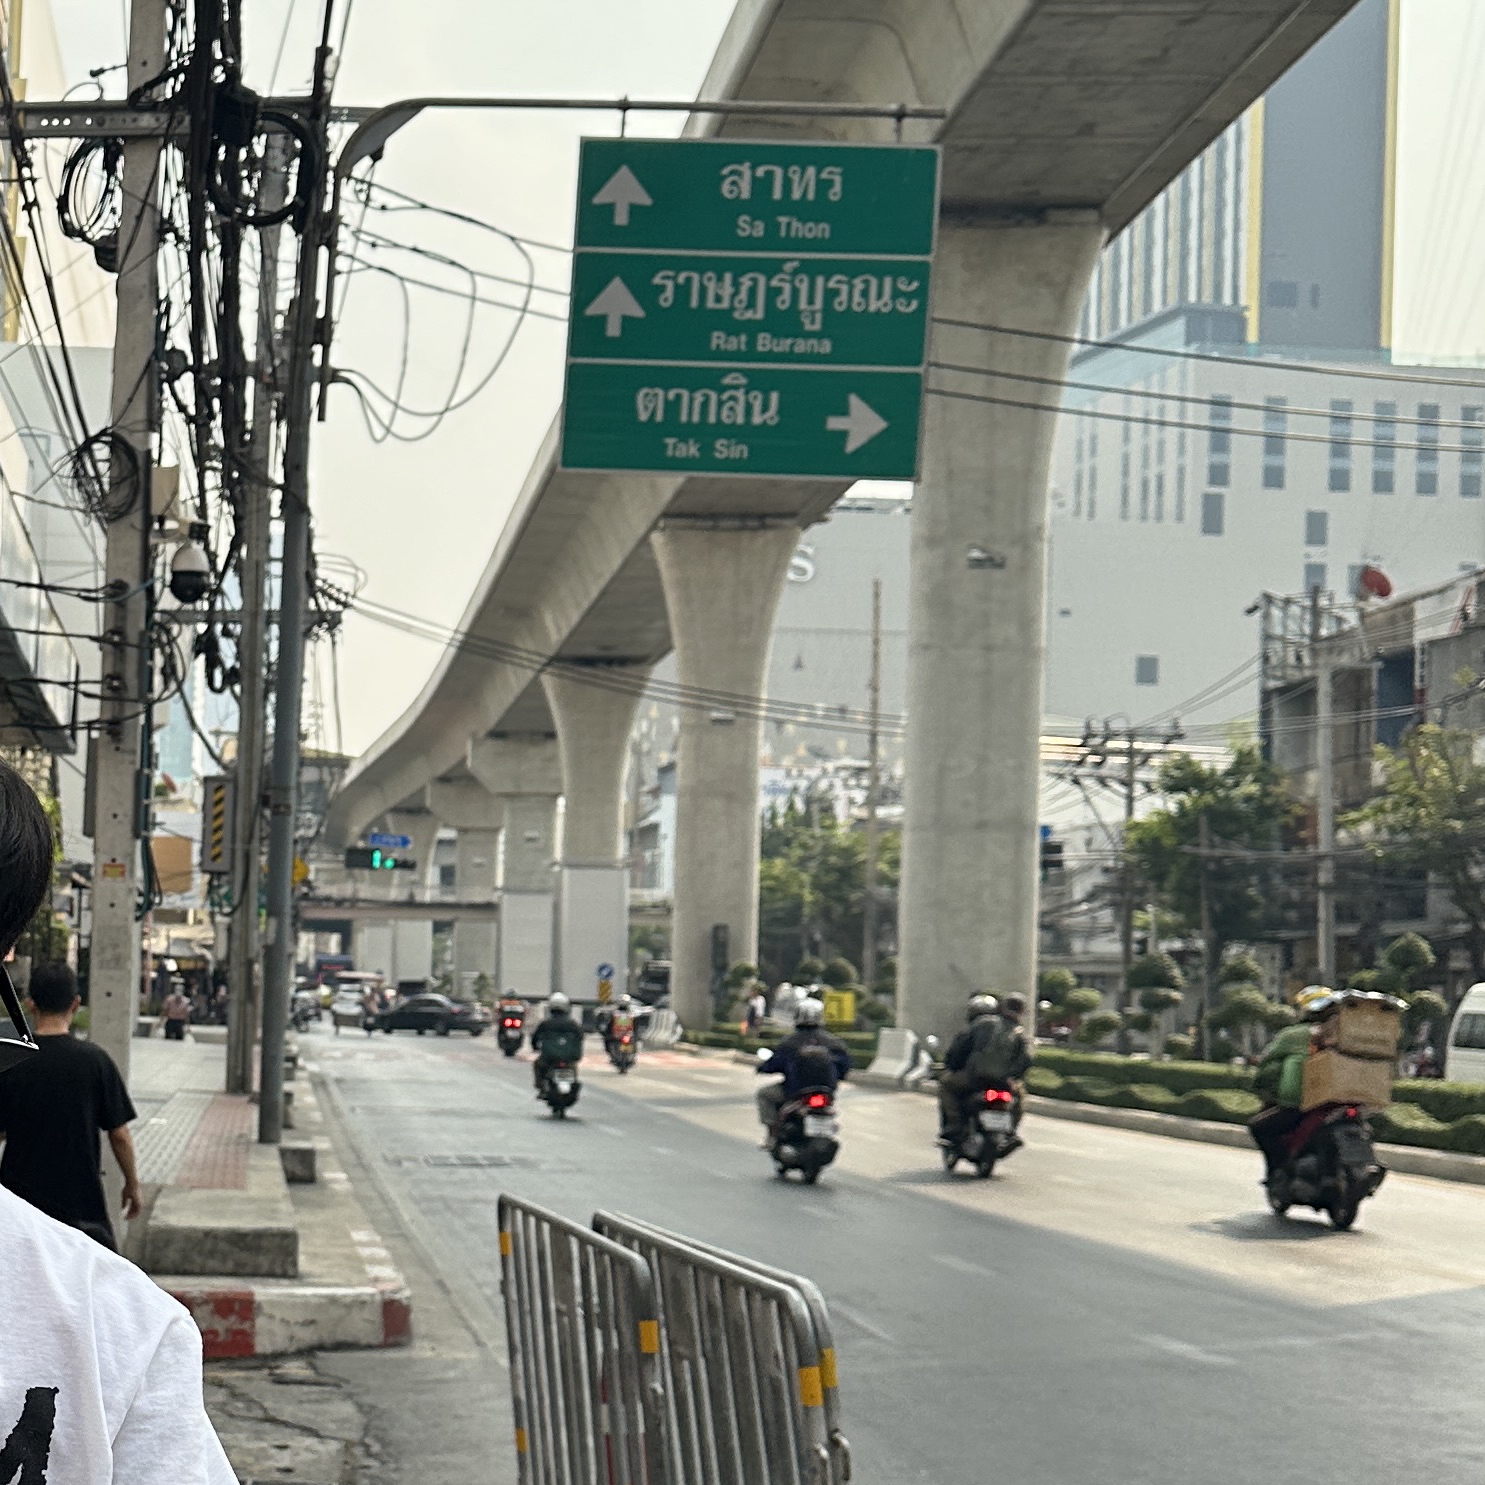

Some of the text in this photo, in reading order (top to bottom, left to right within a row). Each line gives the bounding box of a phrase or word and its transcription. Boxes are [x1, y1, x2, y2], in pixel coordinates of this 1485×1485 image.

[719, 161, 844, 201] สาทร
[736, 214, 831, 239] Sa Thon
[651, 260, 921, 331] ราษฎร์บูรณะ
[710, 329, 832, 354] Rat Burana
[636, 372, 781, 426] ตากสิน
[663, 437, 749, 460] Tak Sin
